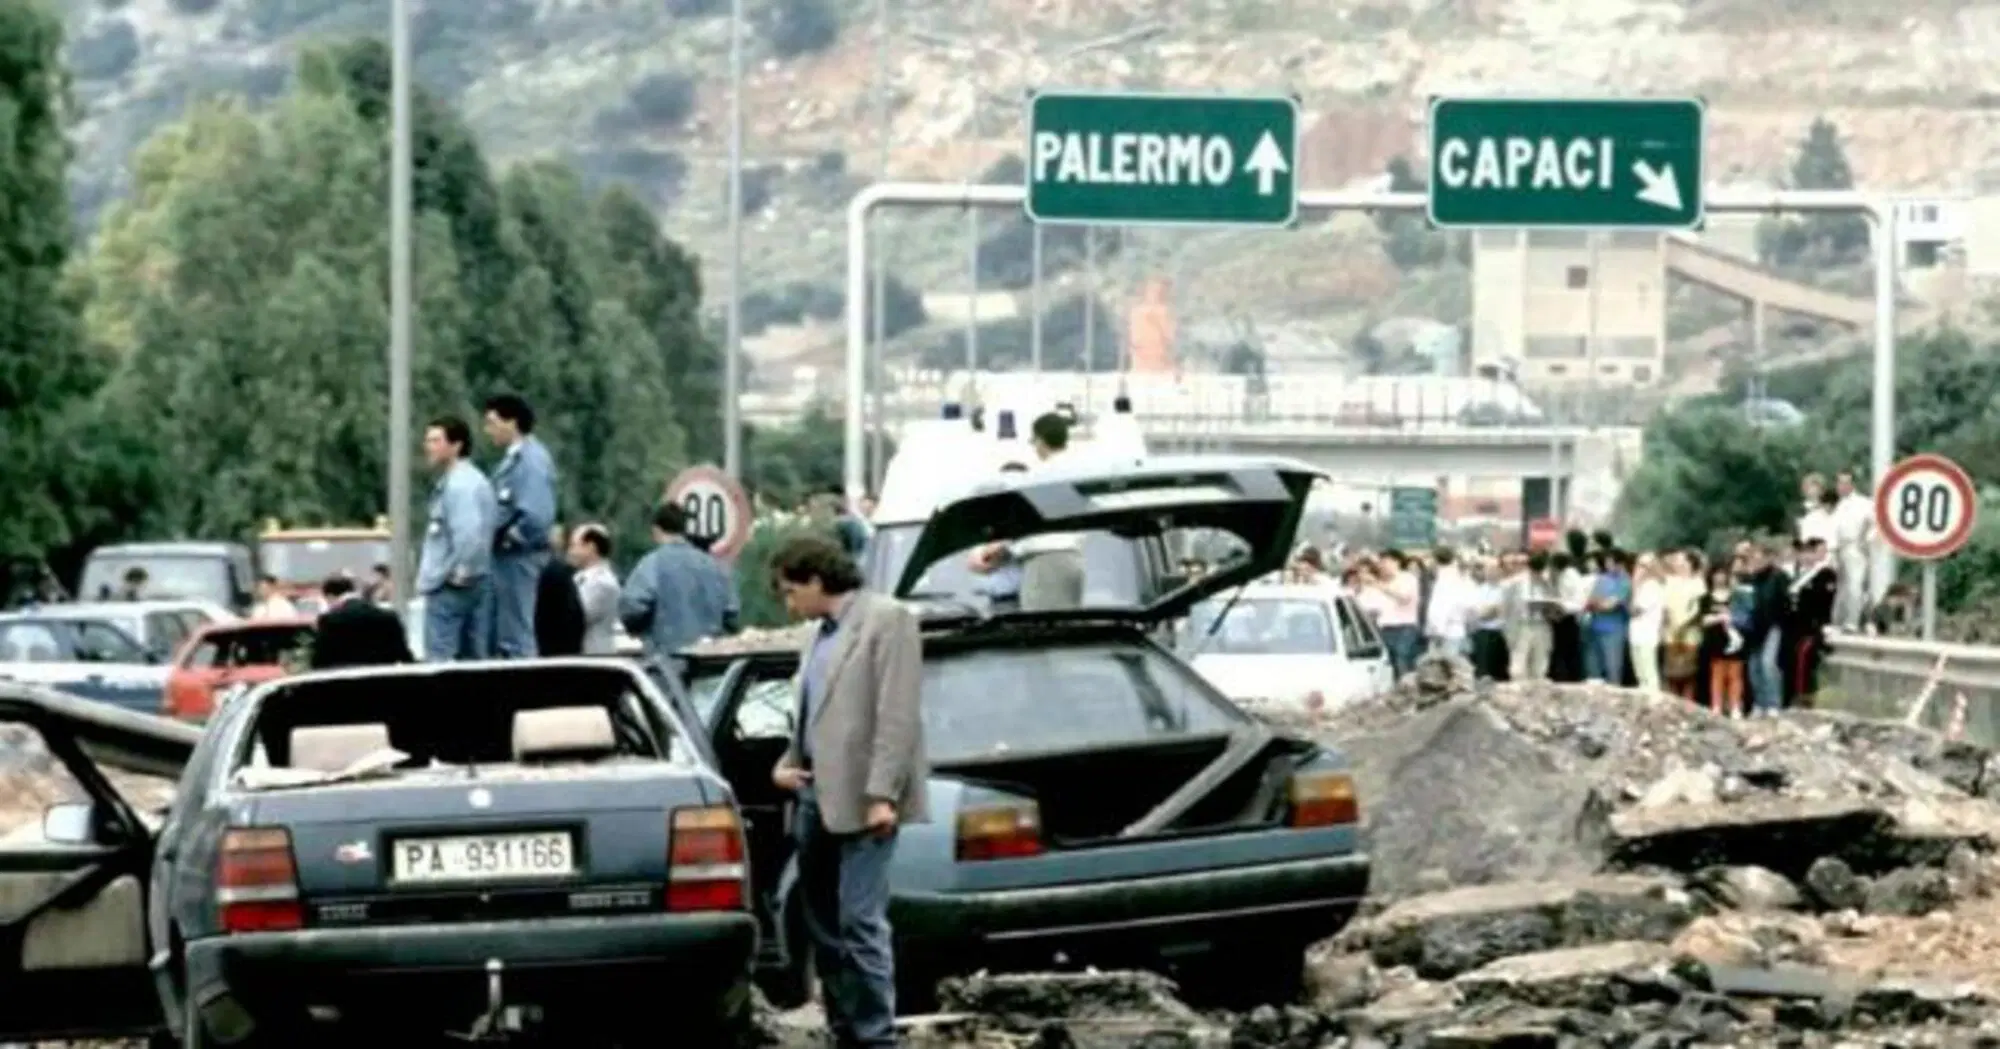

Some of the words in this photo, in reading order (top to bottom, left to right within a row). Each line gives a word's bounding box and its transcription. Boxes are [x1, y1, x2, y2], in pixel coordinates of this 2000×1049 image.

[1034, 131, 1233, 185] PALERMO
[1439, 137, 1614, 189] CAPACI
[684, 492, 726, 541] 80
[1900, 482, 1950, 532] 80
